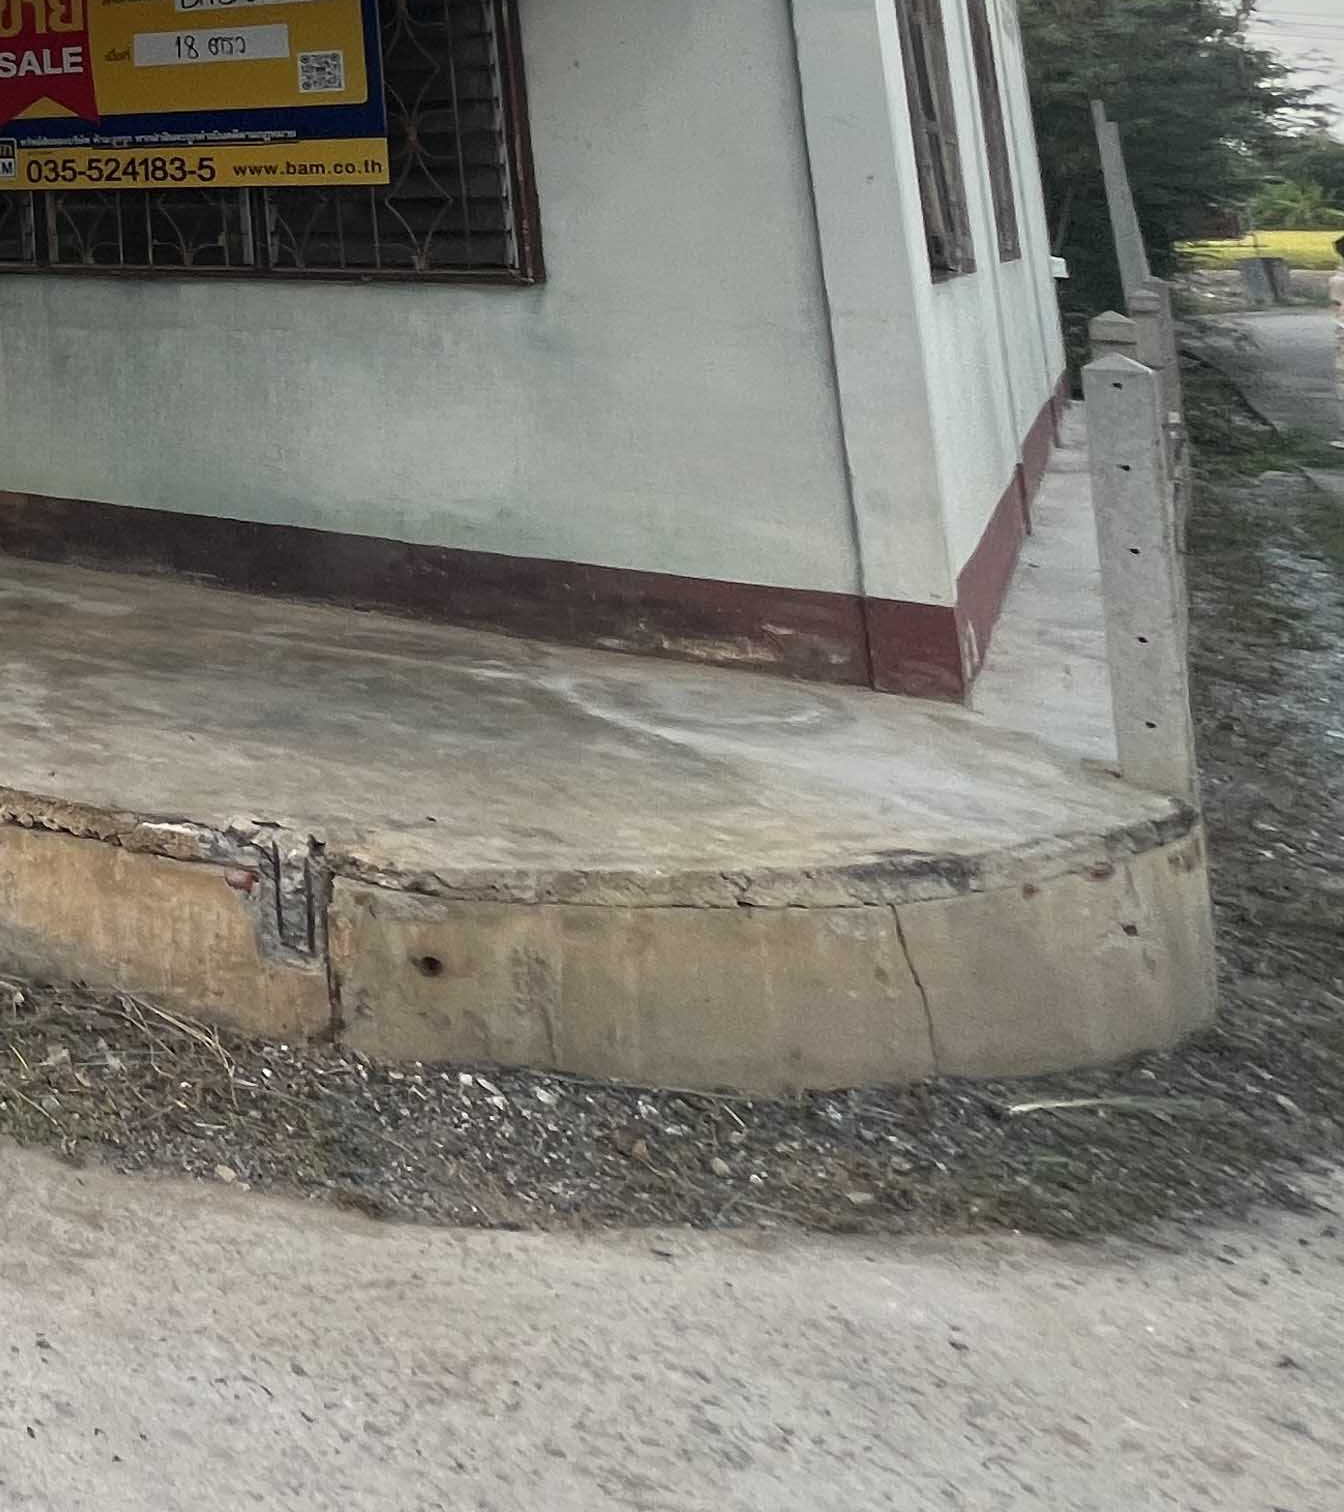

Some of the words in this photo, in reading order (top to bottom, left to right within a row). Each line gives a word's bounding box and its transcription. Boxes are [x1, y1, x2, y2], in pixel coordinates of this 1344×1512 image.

[176, 35, 200, 59] 18
[26, 157, 216, 183] 035-524183-5
[233, 159, 383, 176] www.bam.co.th
